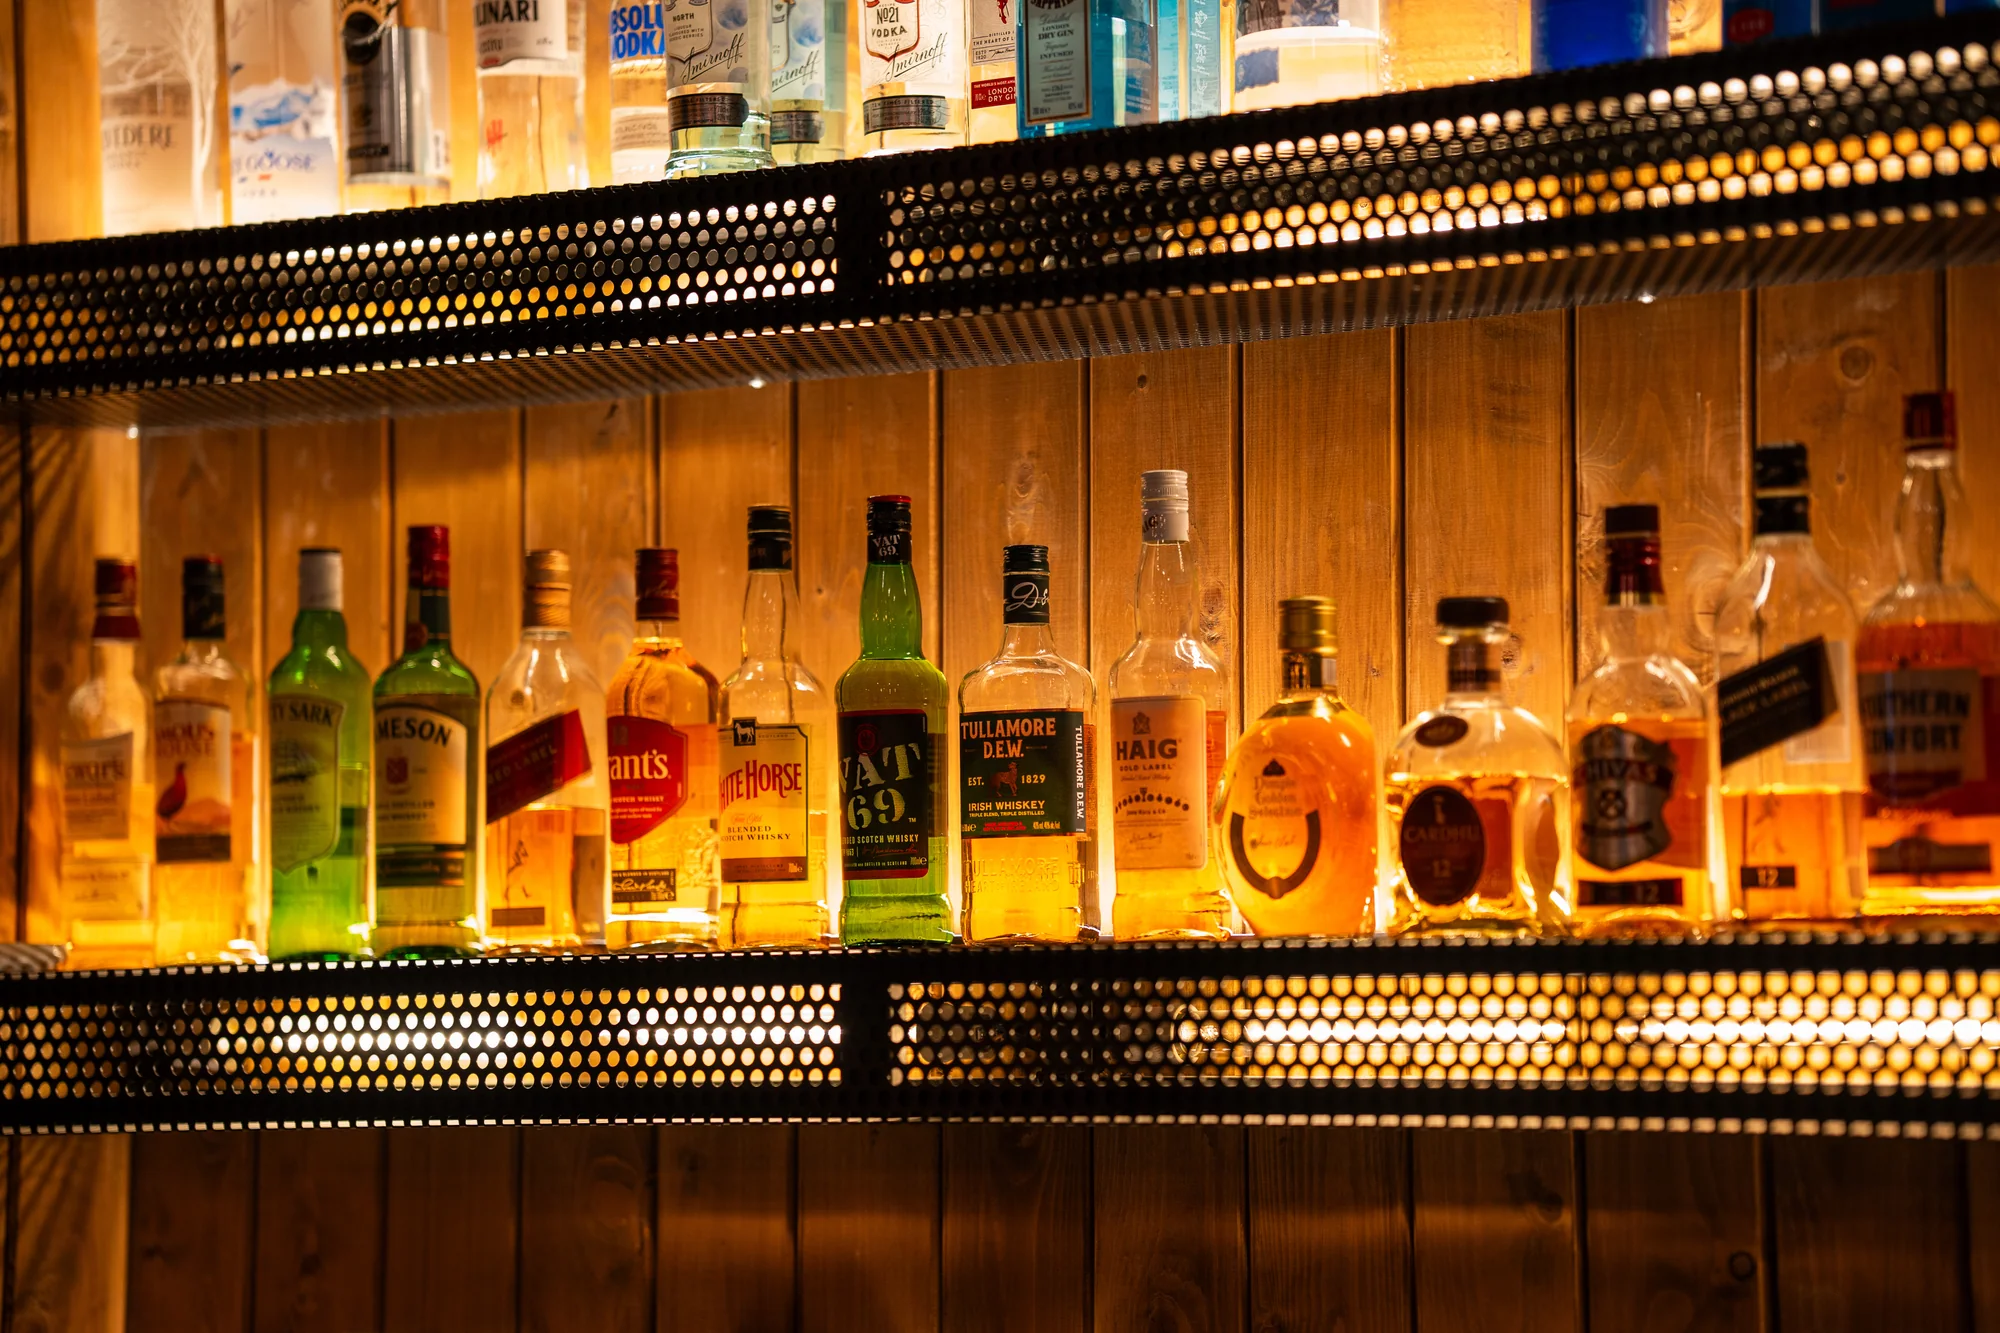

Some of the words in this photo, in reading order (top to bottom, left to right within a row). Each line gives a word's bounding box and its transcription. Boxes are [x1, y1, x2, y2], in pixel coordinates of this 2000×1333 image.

[672, 13, 695, 22] NORTH
[871, 25, 908, 38] VODKA
[1038, 31, 1056, 40] DRY
[1057, 29, 1075, 38] GIN
[1042, 23, 1070, 32] LONDON
[682, 32, 746, 84] Smirnoff
[884, 32, 948, 82] Smirnoff
[988, 95, 1003, 103] DRY
[872, 534, 901, 548] VAT
[289, 702, 333, 728] SARK
[960, 717, 1056, 740] TULLAMORE
[983, 739, 1025, 759] D.E.W.
[1116, 739, 1178, 761] HAIG
[1075, 725, 1084, 788] TULLAMORE
[1119, 764, 1139, 772] GOLD
[1142, 763, 1173, 771] LABEL
[745, 760, 803, 799] HORSE
[968, 776, 985, 786] EST.
[1021, 773, 1047, 785] 1829
[847, 788, 906, 831] 69
[968, 802, 992, 812] IRISH
[995, 800, 1045, 811] WHISKEY
[1076, 792, 1085, 819] D.E.W.
[727, 826, 772, 834] BLENDED
[747, 833, 791, 842] WHISKY
[857, 835, 885, 845] SCOTCH
[886, 834, 919, 844] WHISKY
[1432, 859, 1452, 879] 12
[1757, 867, 1780, 887] 12
